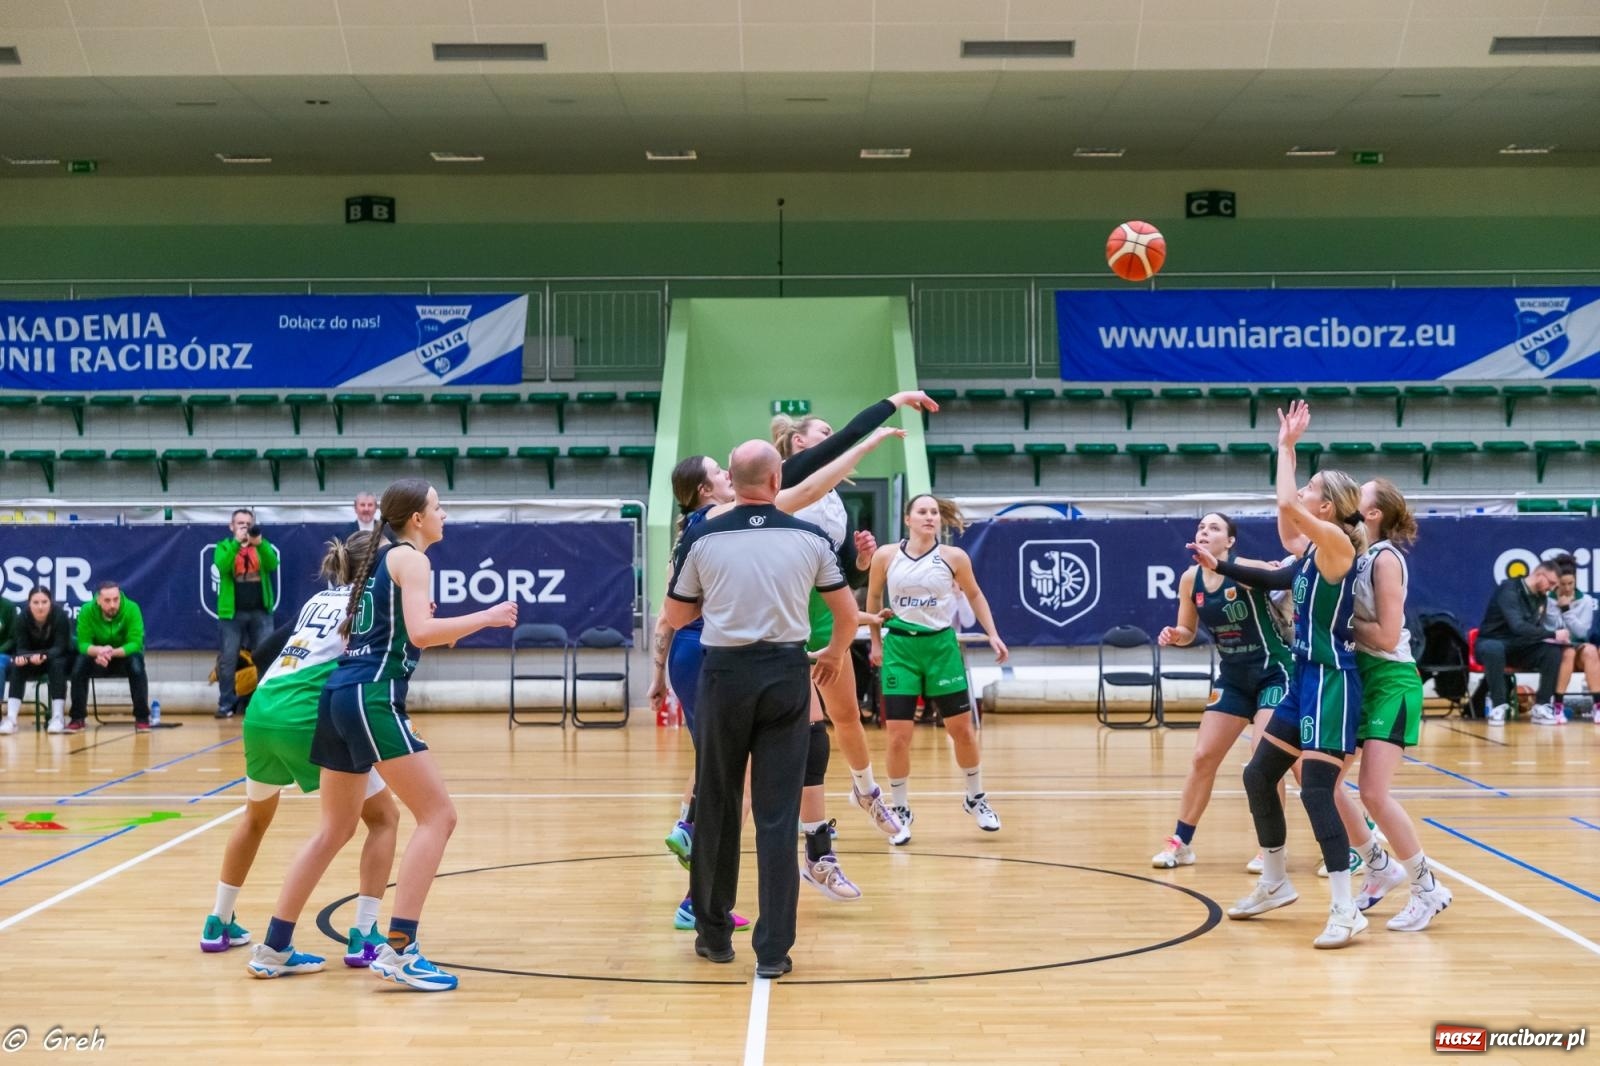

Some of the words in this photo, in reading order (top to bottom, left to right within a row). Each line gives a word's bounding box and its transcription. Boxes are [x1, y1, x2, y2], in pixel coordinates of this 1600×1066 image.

[349, 205, 361, 220] B
[373, 204, 389, 219] B
[1191, 200, 1208, 214] C
[1219, 200, 1232, 214] C
[0, 312, 166, 342] KADEMIA
[279, 315, 325, 332] Dołącz
[330, 315, 347, 329] do
[352, 314, 381, 329] nas!
[1099, 318, 1455, 349] www.uniaraciborz.eu
[421, 331, 464, 359] UNIA
[1520, 323, 1563, 351] UNIA
[0, 347, 55, 373] NII
[71, 336, 253, 373] RACIBÓRZ
[0, 556, 93, 602] SiR
[900, 596, 937, 607] Clavis
[1222, 600, 1248, 622] 10
[293, 603, 341, 639] 14
[1300, 716, 1314, 743] 6
